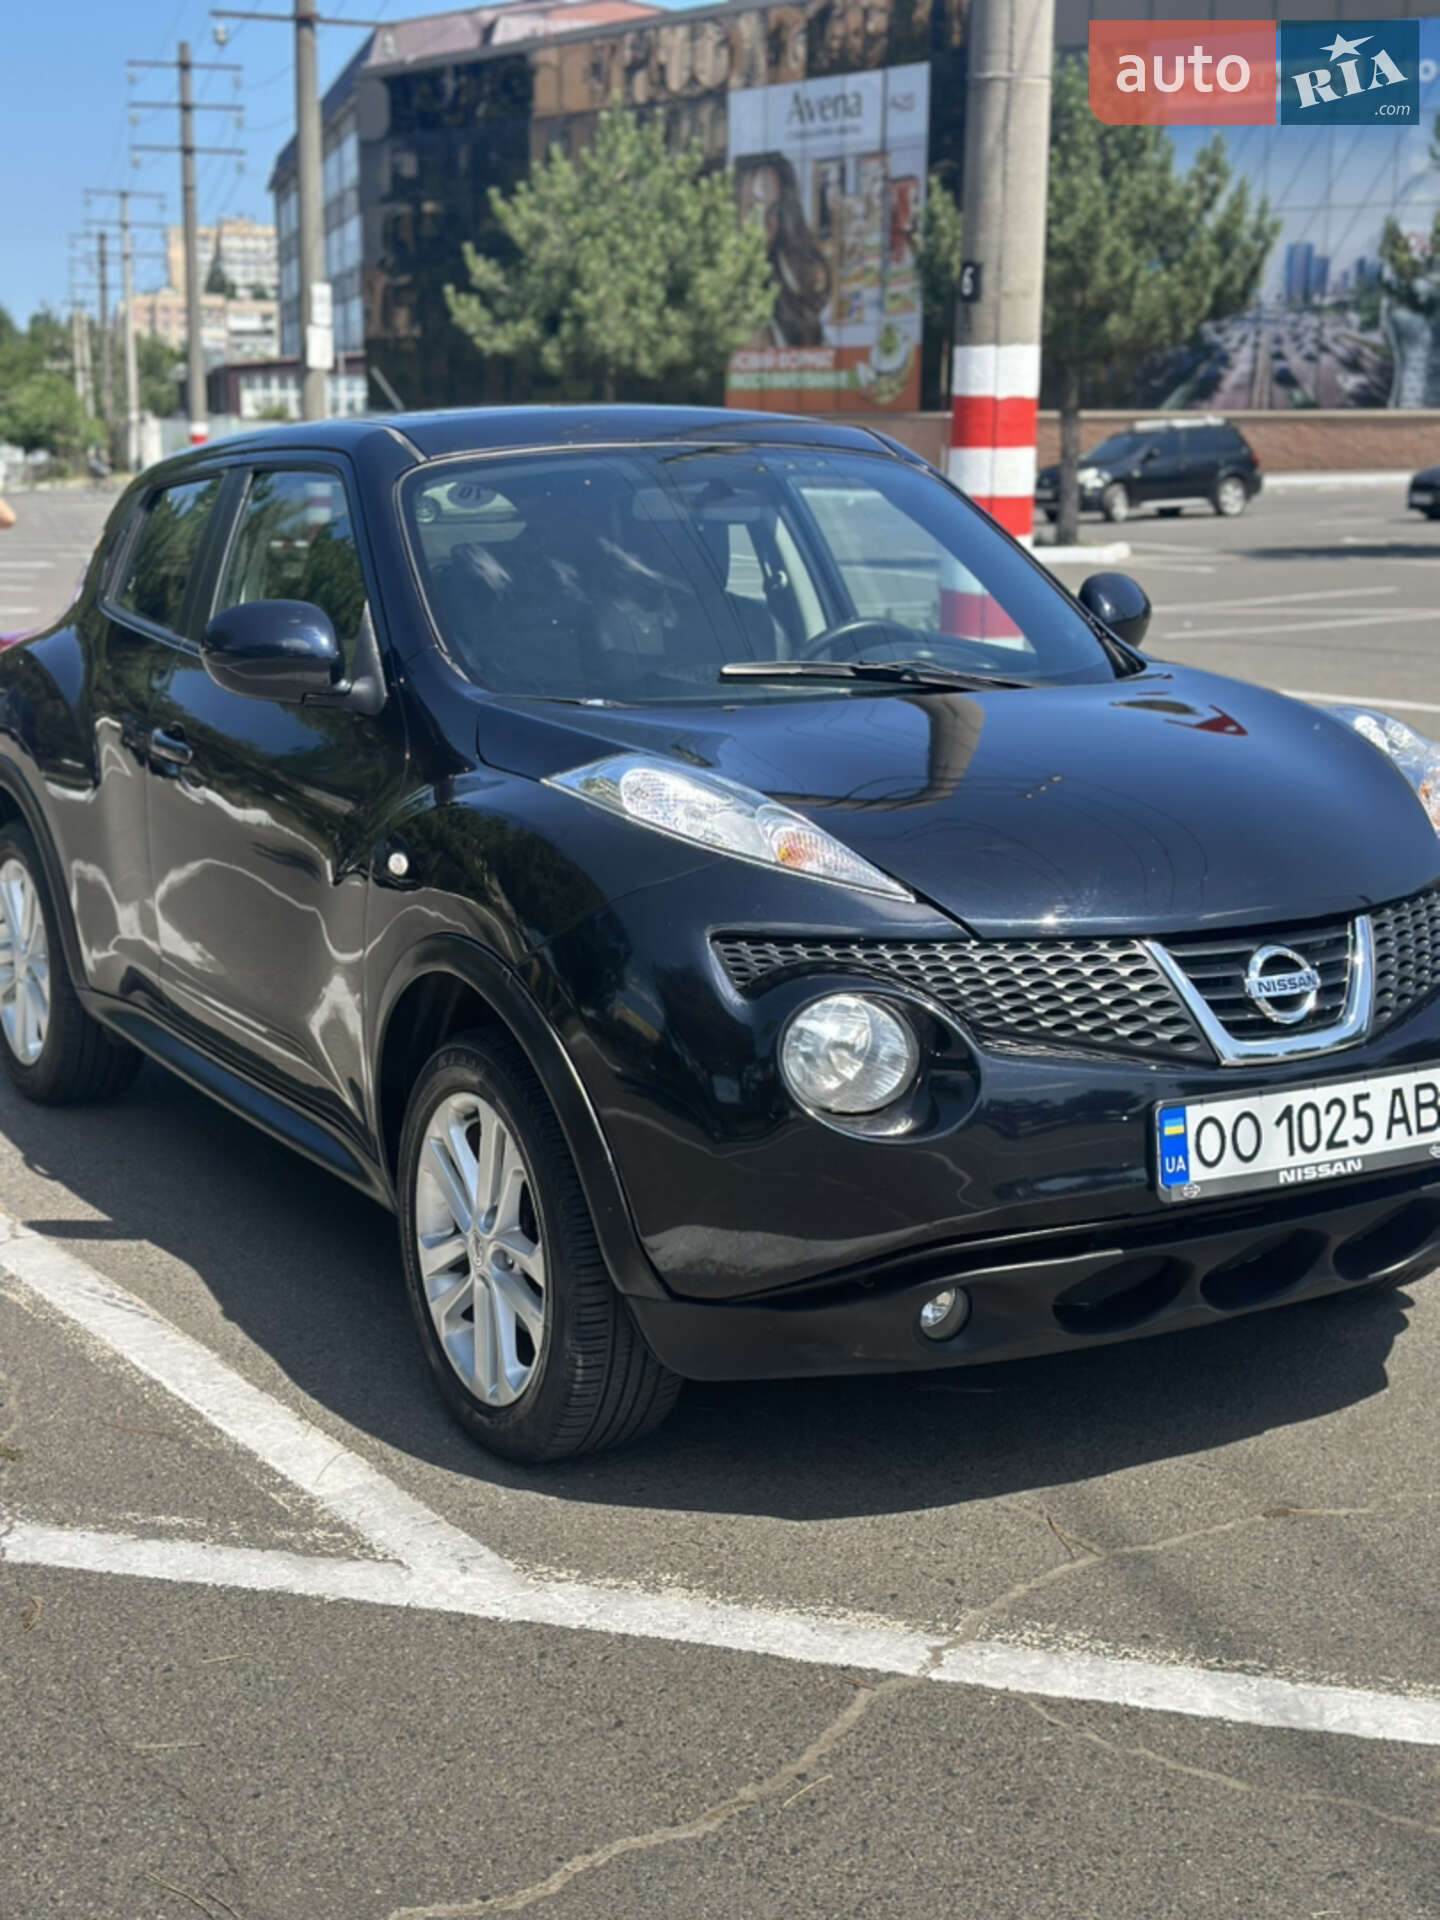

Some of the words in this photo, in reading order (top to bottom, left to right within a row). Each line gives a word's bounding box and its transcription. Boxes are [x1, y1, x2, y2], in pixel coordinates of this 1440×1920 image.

[785, 91, 862, 124] Avena
[1257, 974, 1317, 993] NISSAN
[1195, 1111, 1262, 1168] OO
[1274, 1092, 1373, 1157] 1025
[1386, 1082, 1440, 1140] AB
[1165, 1156, 1187, 1174] UA
[1279, 1158, 1363, 1184] NISSAN
